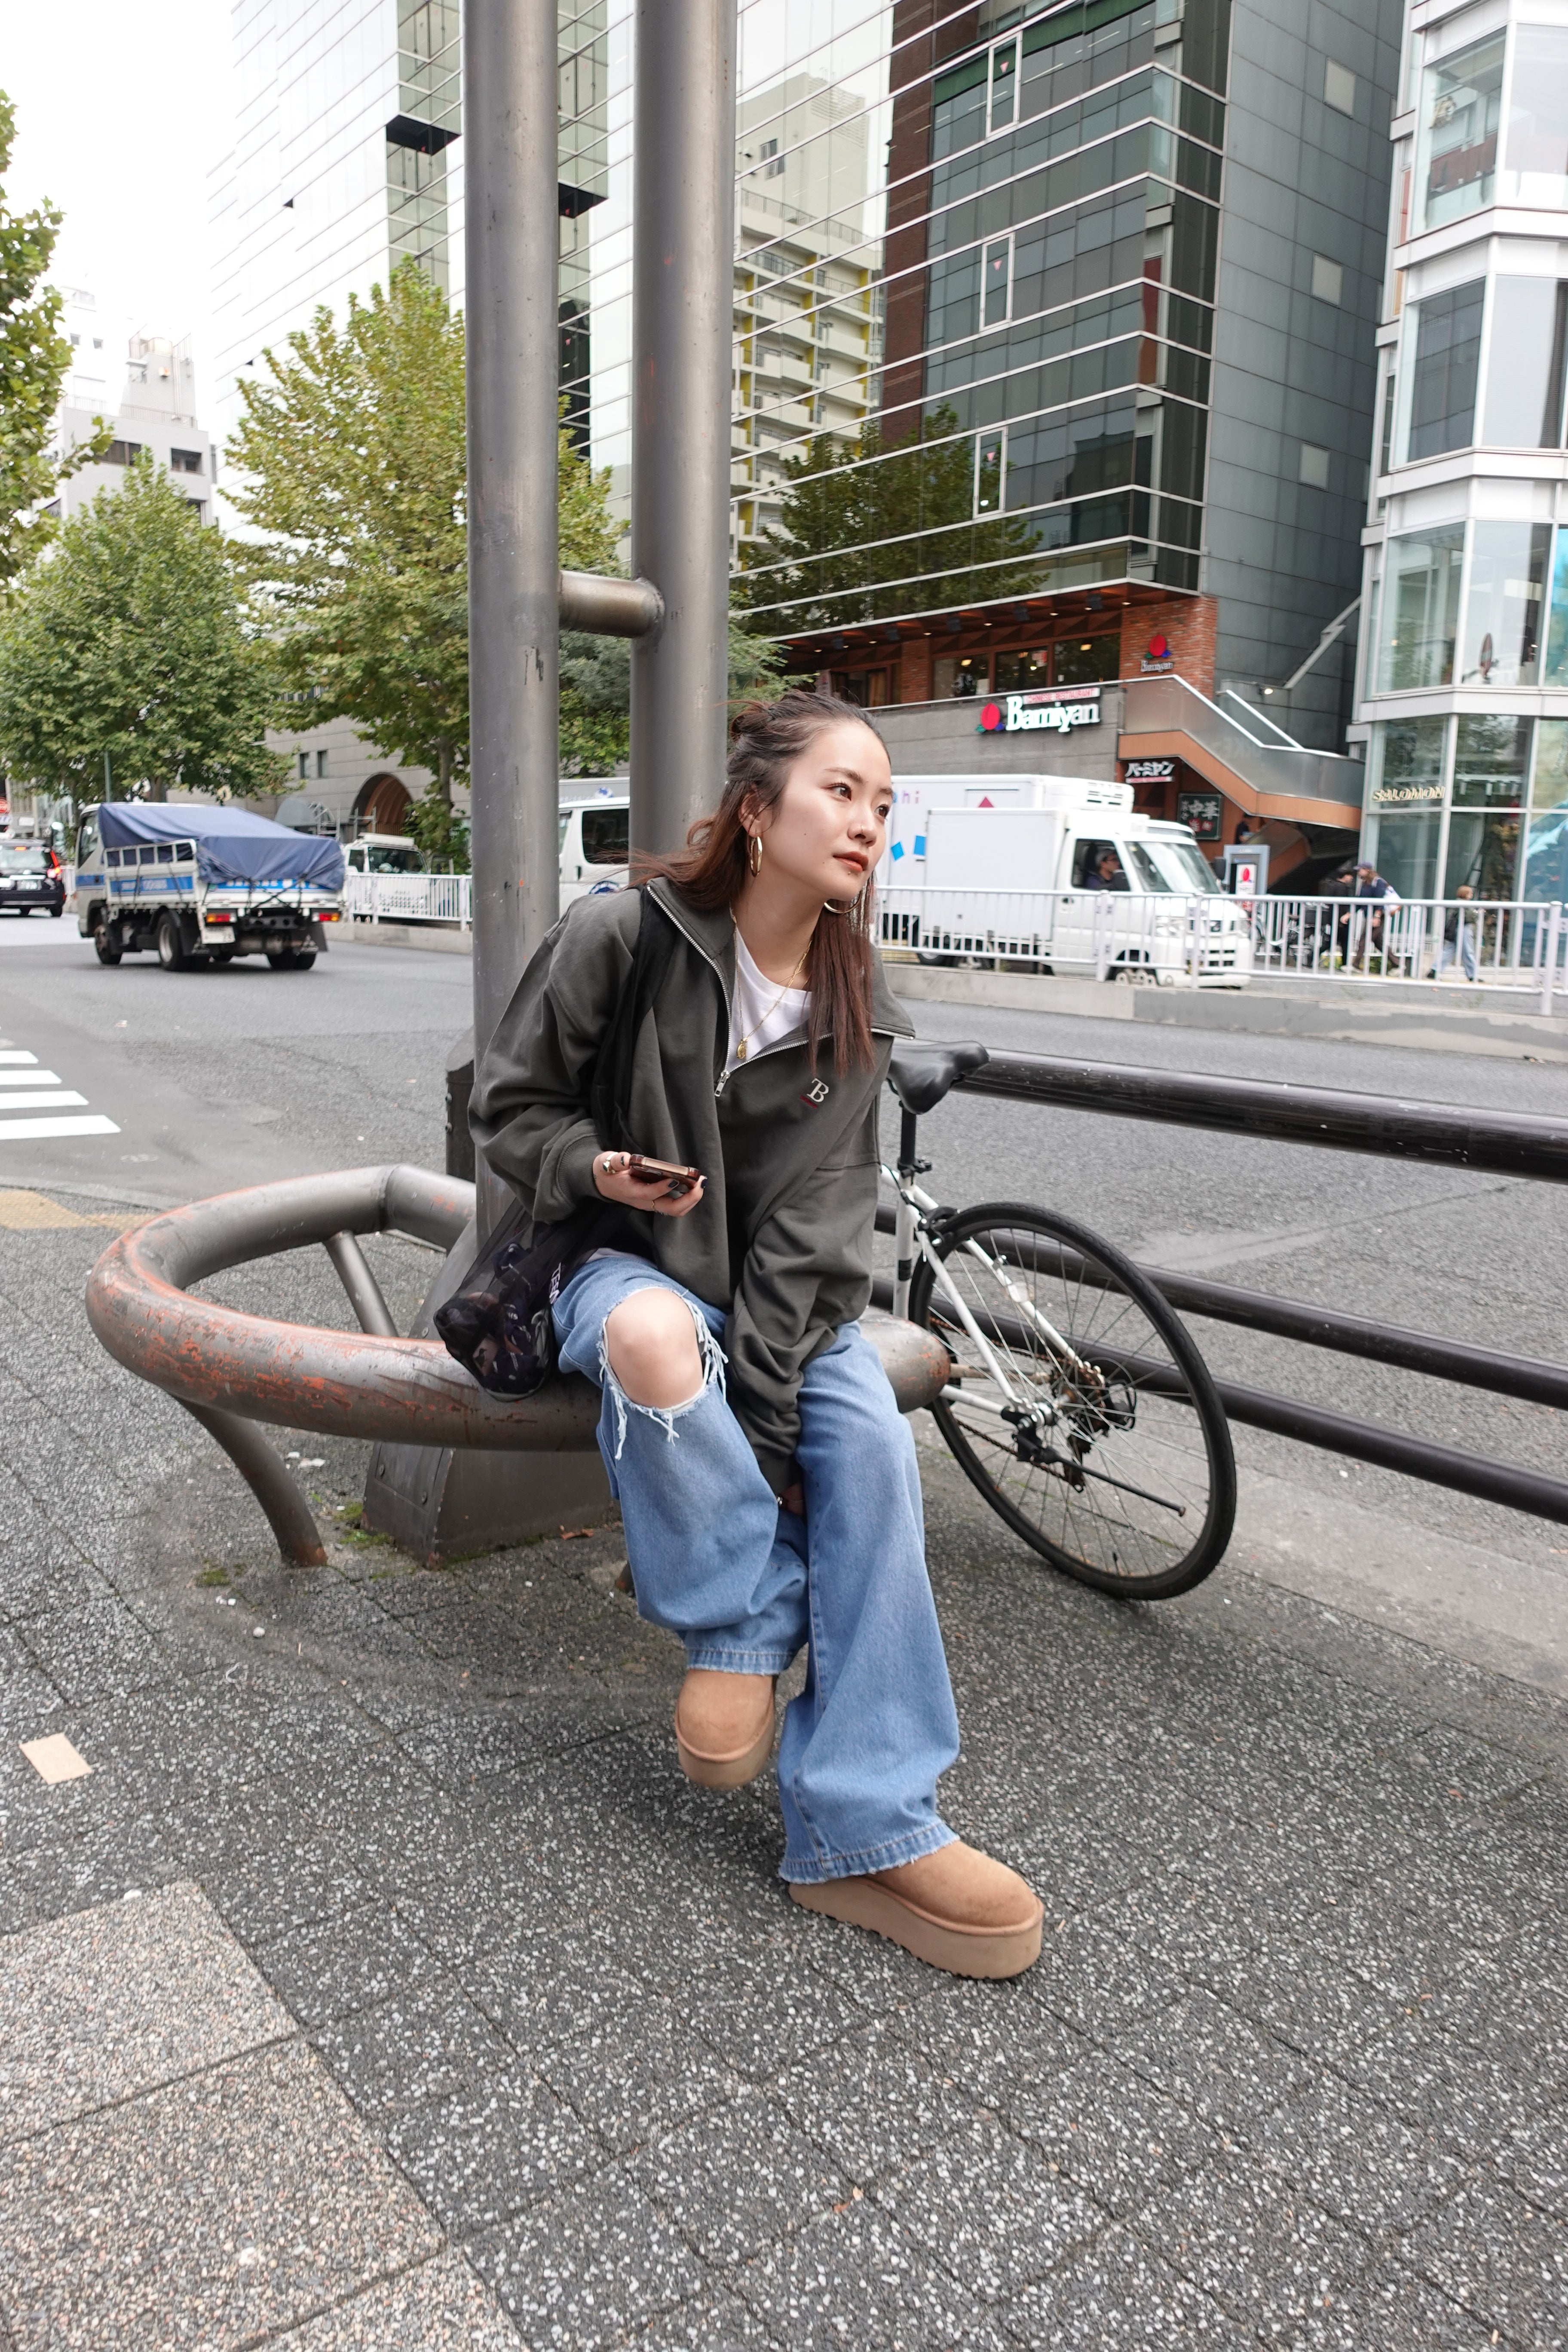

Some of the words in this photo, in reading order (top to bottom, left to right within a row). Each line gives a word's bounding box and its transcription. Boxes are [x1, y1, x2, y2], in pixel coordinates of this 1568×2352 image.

[1005, 695, 1100, 732] Bamiyan
[1124, 761, 1175, 777] バーミヤン
[1372, 786, 1446, 802] SALOMON
